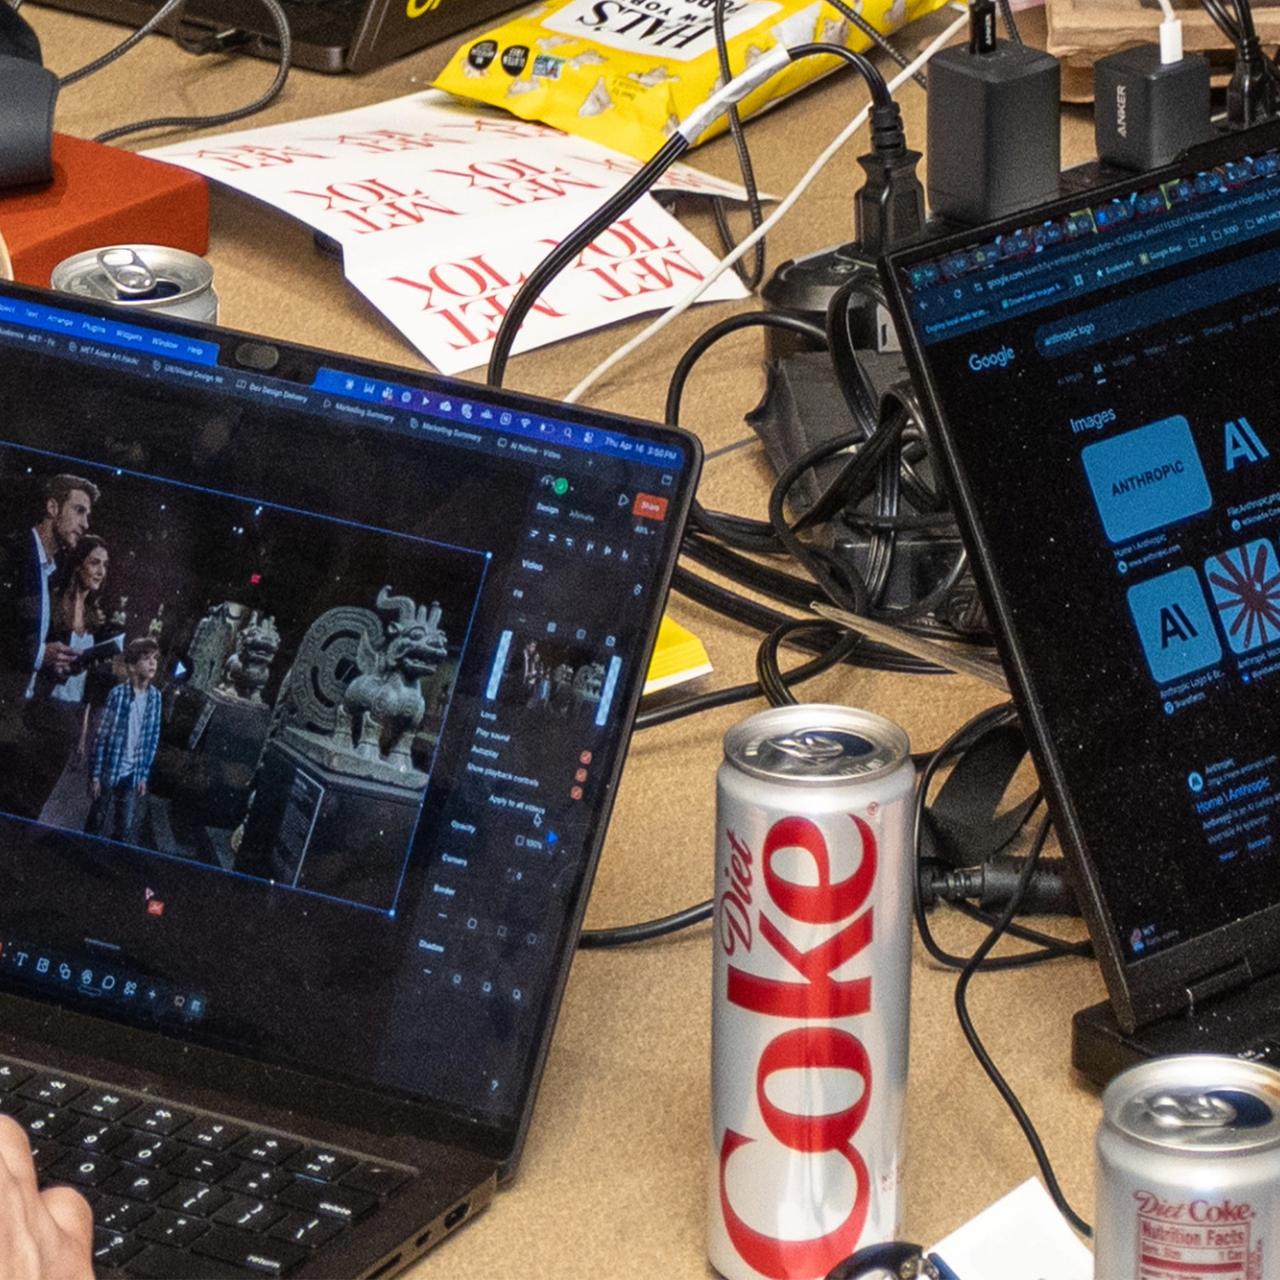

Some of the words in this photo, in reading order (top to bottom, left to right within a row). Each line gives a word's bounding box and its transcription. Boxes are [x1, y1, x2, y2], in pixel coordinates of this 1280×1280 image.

[575, 0, 714, 49] HAL'S
[1116, 84, 1127, 138] ANKER
[47, 314, 74, 328] Arrange
[82, 321, 106, 335] Plugins
[116, 328, 143, 342] Widgets
[152, 336, 179, 351] Window
[1044, 327, 1077, 347] anthropic
[1078, 323, 1095, 337] logo
[969, 345, 1015, 371] Google
[422, 421, 453, 437] Marketing
[453, 428, 482, 444] Summary
[1070, 407, 1117, 434] Images
[619, 439, 634, 453] Apr
[484, 767, 513, 782] playback
[1196, 795, 1220, 813] Home
[1228, 776, 1271, 801] Anthropic
[451, 820, 476, 834] Opacity
[441, 853, 467, 867] Corners
[720, 826, 756, 956] Diet
[720, 812, 879, 1280] Coke
[1132, 1190, 1185, 1219] Diet
[1141, 1221, 1201, 1245] Nutrition
[1206, 1228, 1245, 1247] Facts
